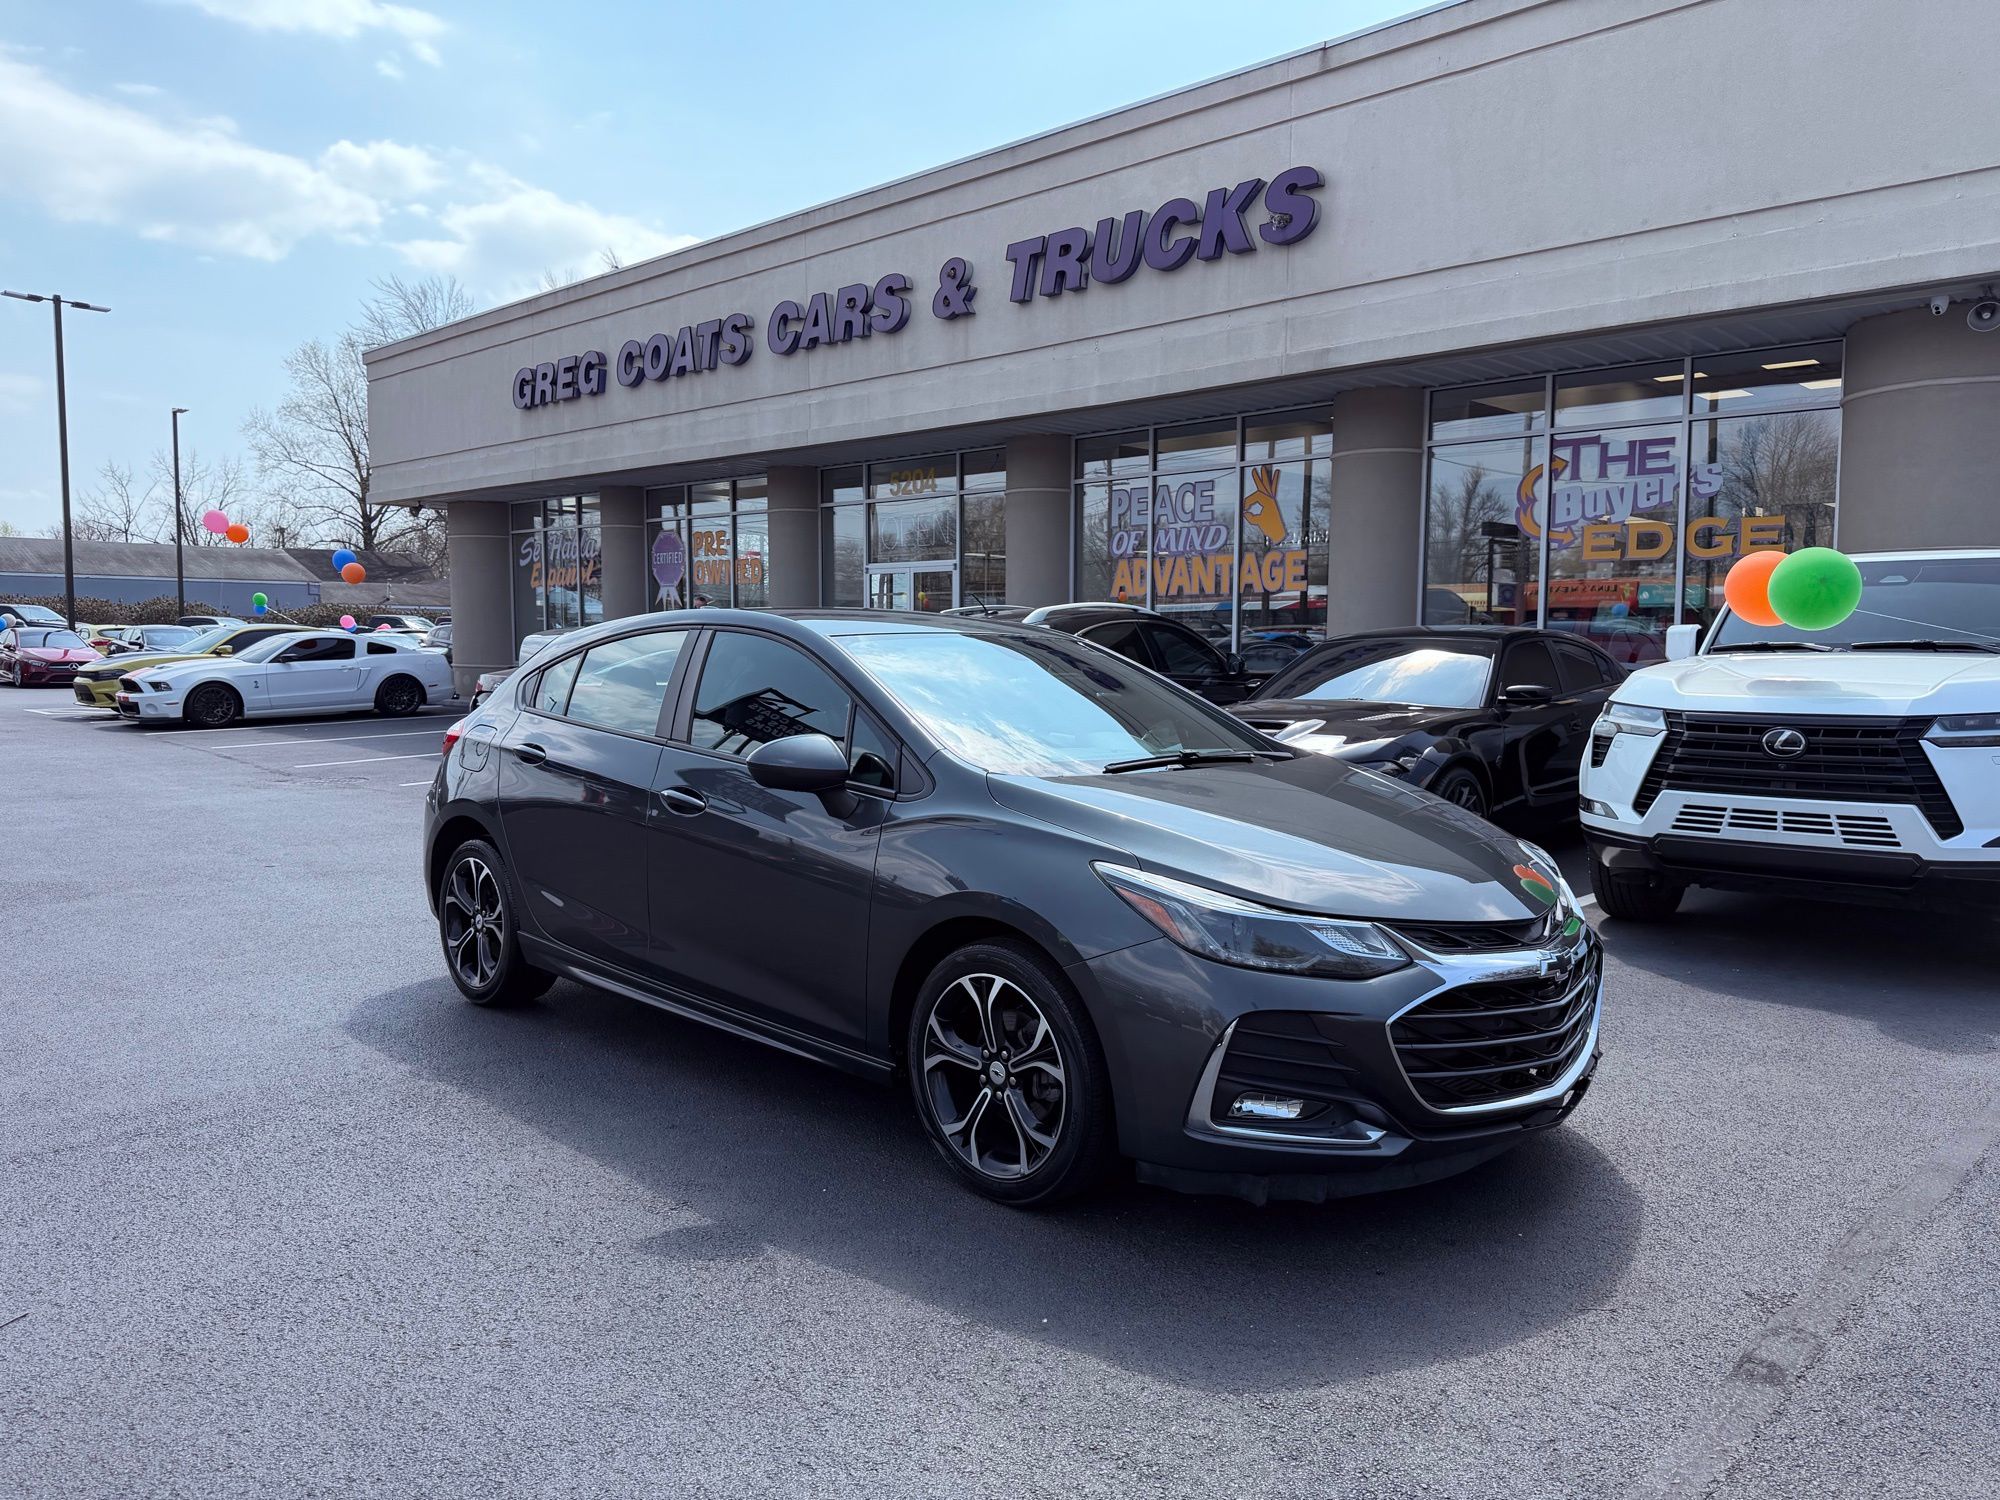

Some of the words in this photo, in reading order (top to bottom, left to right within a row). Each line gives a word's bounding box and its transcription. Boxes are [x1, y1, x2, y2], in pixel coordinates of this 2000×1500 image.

[513, 350, 607, 410] GREG
[616, 313, 754, 387] COATS
[767, 272, 913, 356] CARS
[932, 256, 978, 320] &
[1005, 165, 1325, 304] TRUCKS
[1553, 434, 1676, 480] THE
[890, 467, 938, 496] 5204
[1111, 480, 1215, 527] PEACE
[519, 537, 543, 567] Se
[548, 529, 599, 560] Habla
[653, 551, 683, 564] CERTIFIED
[693, 530, 731, 557] PRE-
[1110, 530, 1145, 557] OF
[1154, 525, 1228, 552] MIND
[1581, 515, 1786, 561] EDGE
[1110, 550, 1308, 597] ADVANTAGE
